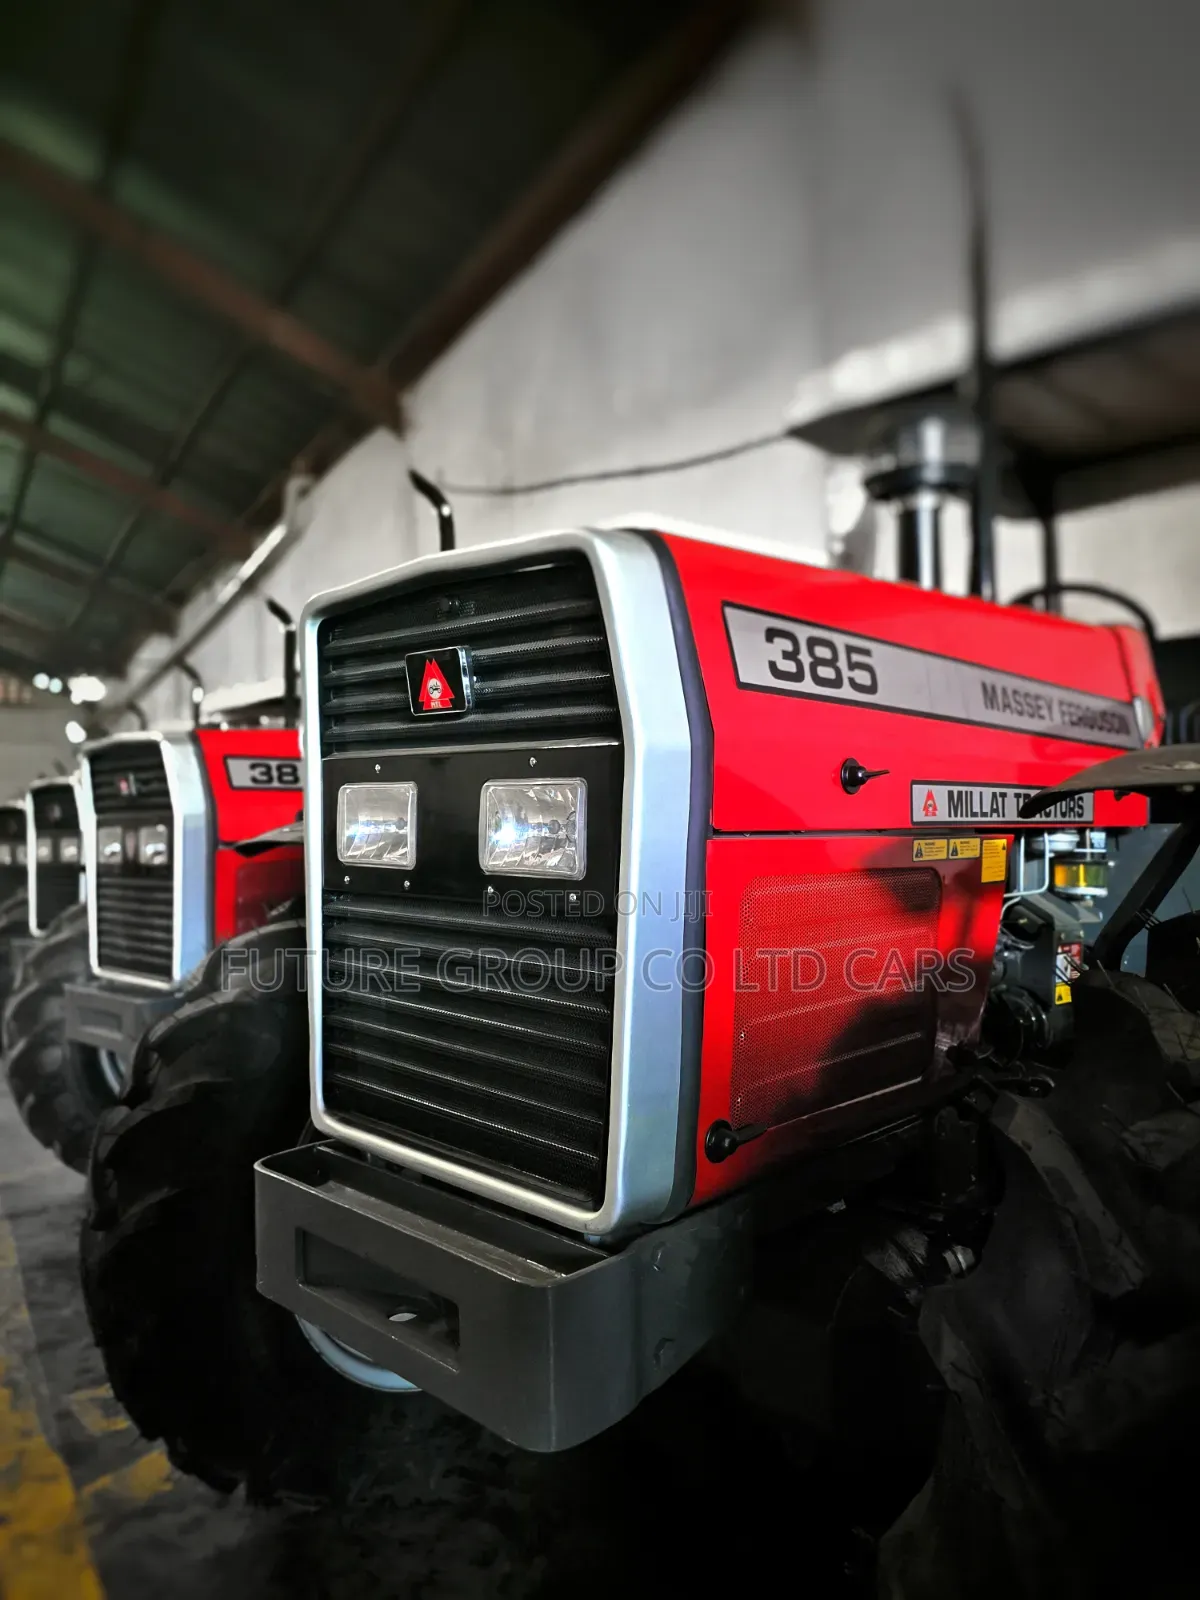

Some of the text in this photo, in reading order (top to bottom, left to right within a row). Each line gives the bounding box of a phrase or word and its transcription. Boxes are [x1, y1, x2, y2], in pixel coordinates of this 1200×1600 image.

[765, 626, 879, 695] 385
[980, 680, 1055, 722] MASSEY
[947, 789, 1008, 818] MILLAT
